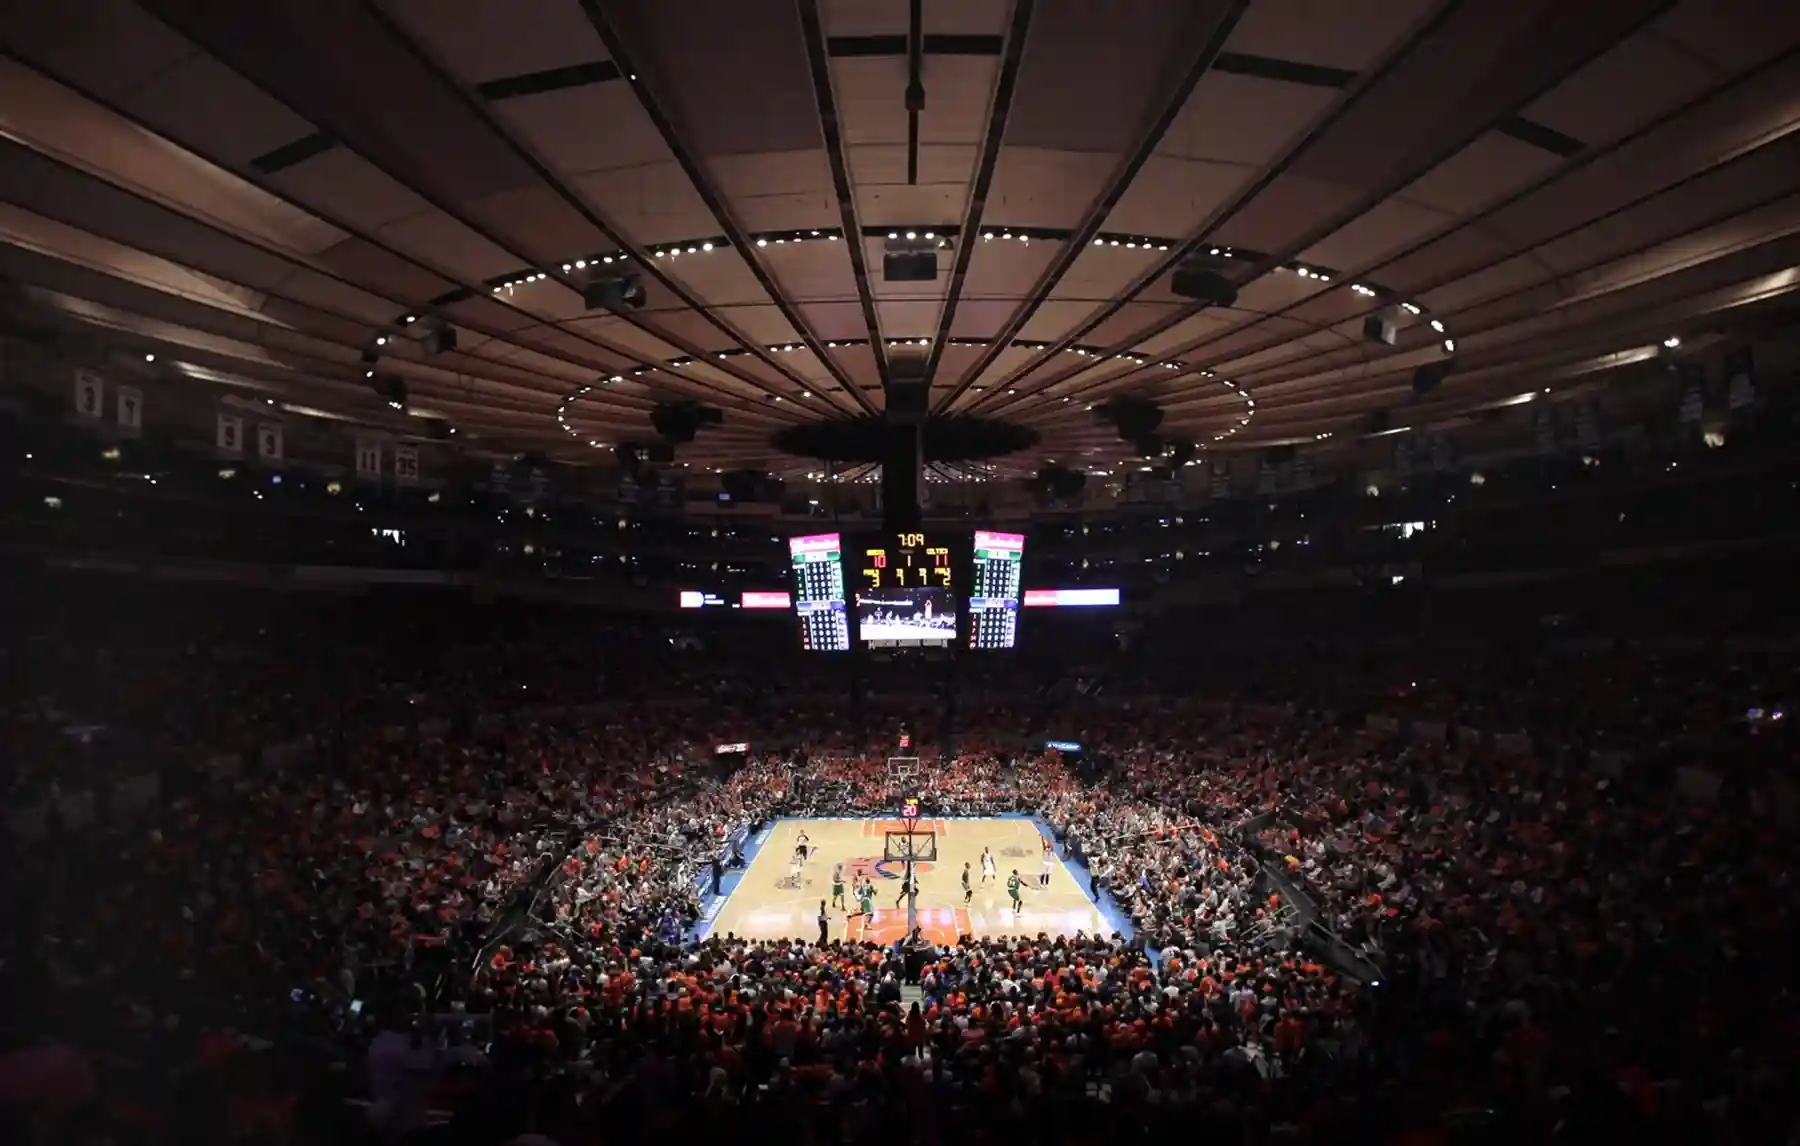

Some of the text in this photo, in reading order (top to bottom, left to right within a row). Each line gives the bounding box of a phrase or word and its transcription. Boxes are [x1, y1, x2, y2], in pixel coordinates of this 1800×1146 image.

[362, 451, 376, 471] 11
[897, 533, 925, 547] 7:09
[874, 555, 887, 568] 10
[903, 805, 917, 817] 20
